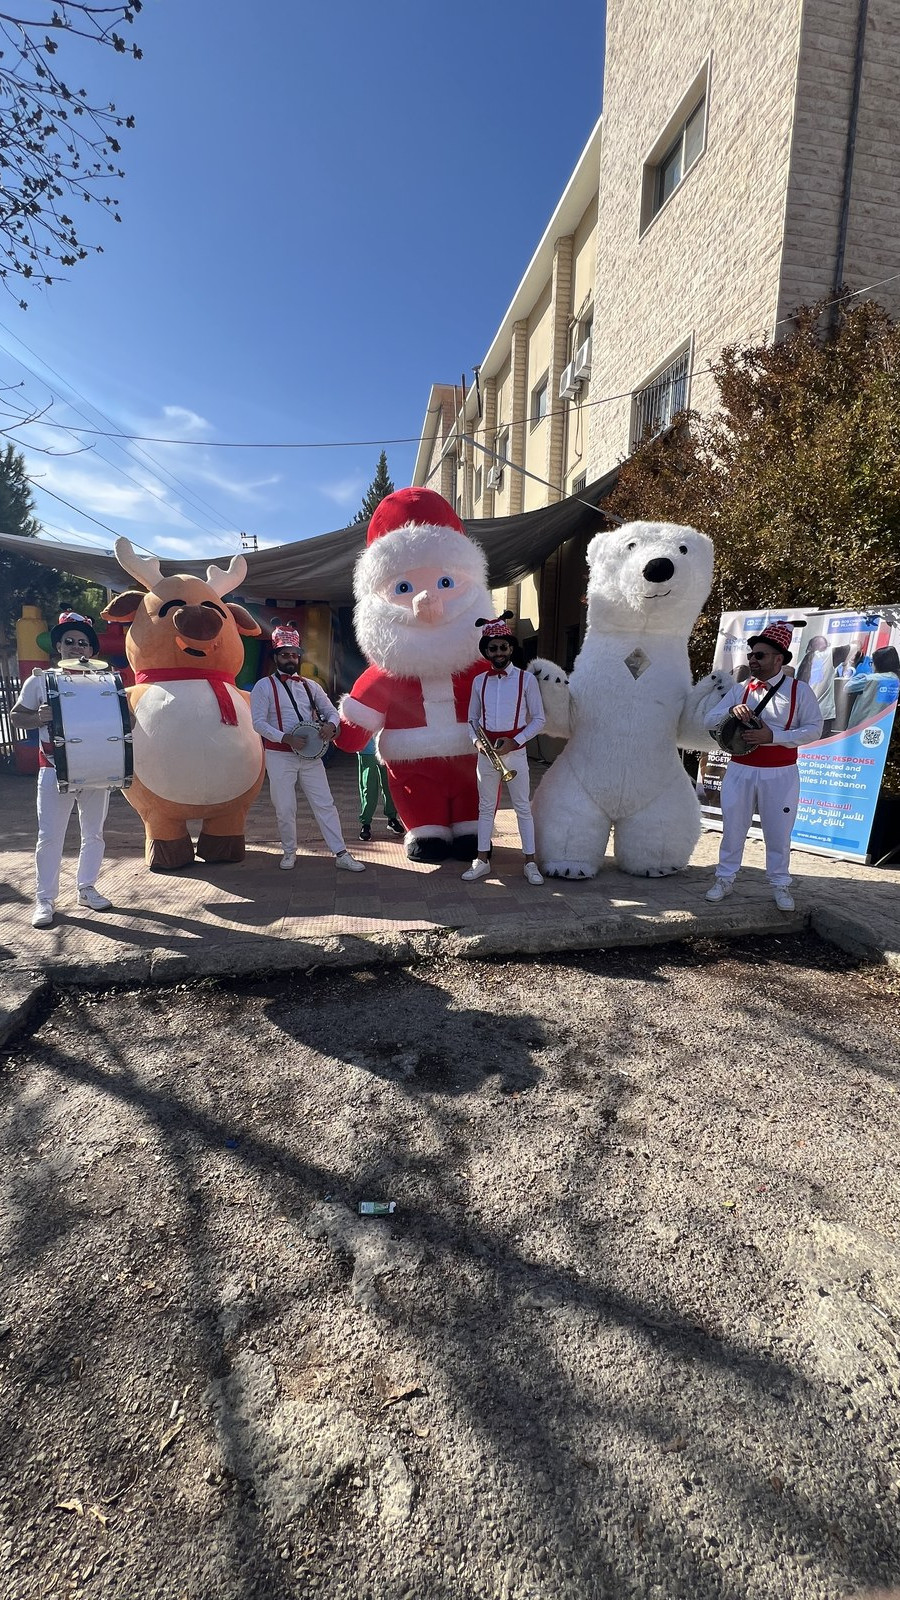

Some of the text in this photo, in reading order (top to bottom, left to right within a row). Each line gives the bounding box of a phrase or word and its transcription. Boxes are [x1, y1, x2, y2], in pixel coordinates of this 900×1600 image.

[832, 756, 875, 765] RESPONSE
[809, 761, 843, 770] Displaced
[799, 776, 867, 790] ilies in Lebanon
[798, 797, 815, 805] الطا
[796, 812, 809, 821] لبنا
[809, 815, 823, 826] في
